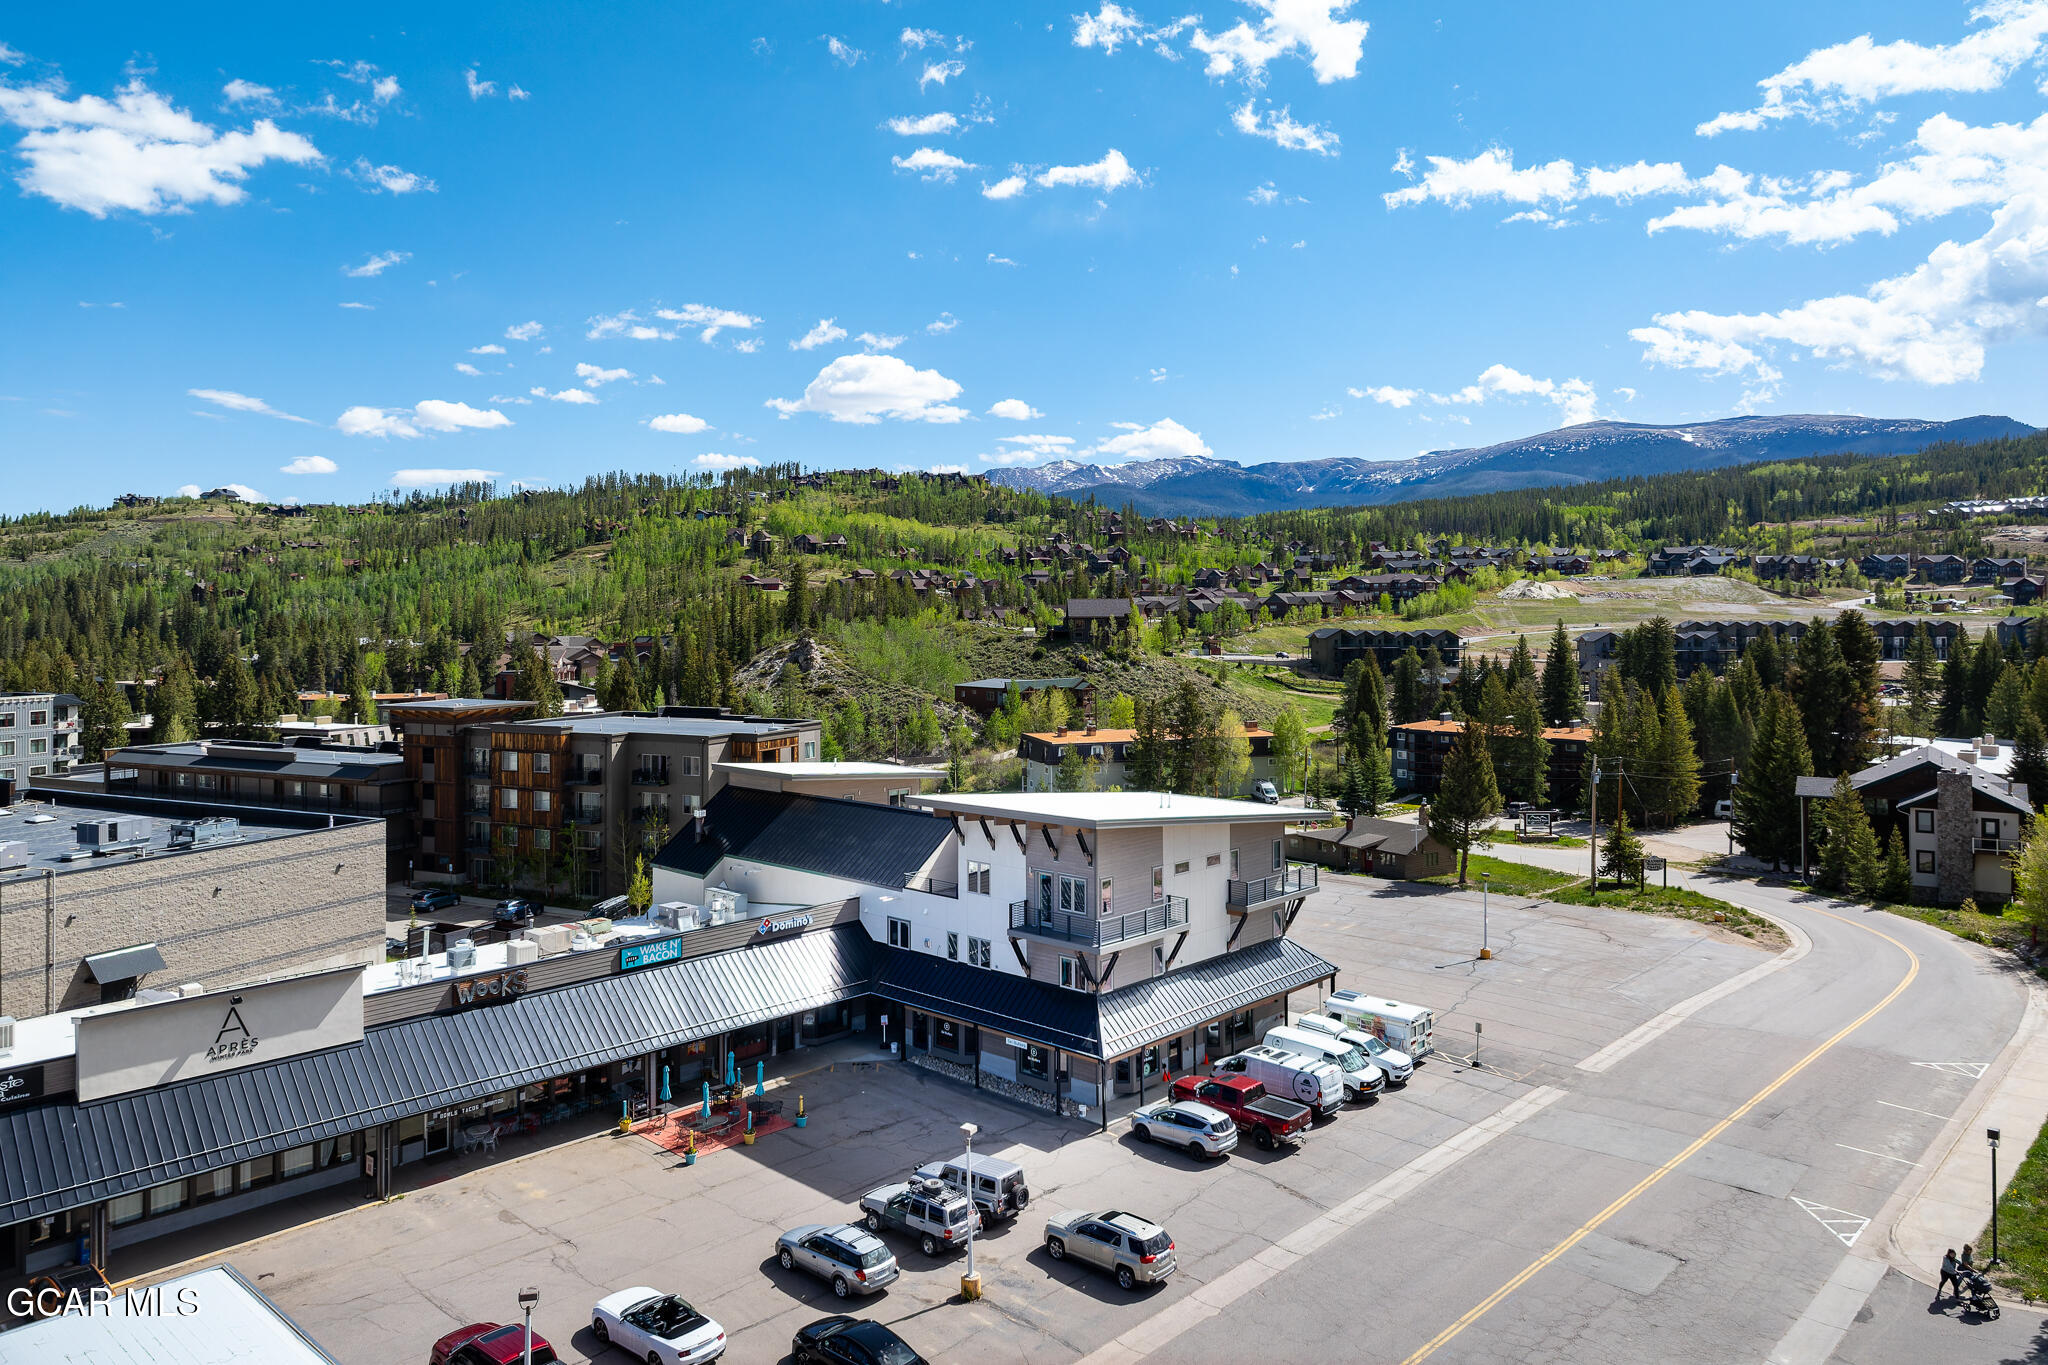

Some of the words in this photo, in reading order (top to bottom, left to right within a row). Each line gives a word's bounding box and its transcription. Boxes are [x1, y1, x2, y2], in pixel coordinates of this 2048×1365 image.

[772, 915, 813, 932] Domino's
[639, 941, 667, 955] WAKE
[643, 949, 678, 964] BACON
[206, 1037, 259, 1057] APRÈS
[211, 1052, 236, 1061] WINTER
[237, 1048, 254, 1056] PARK
